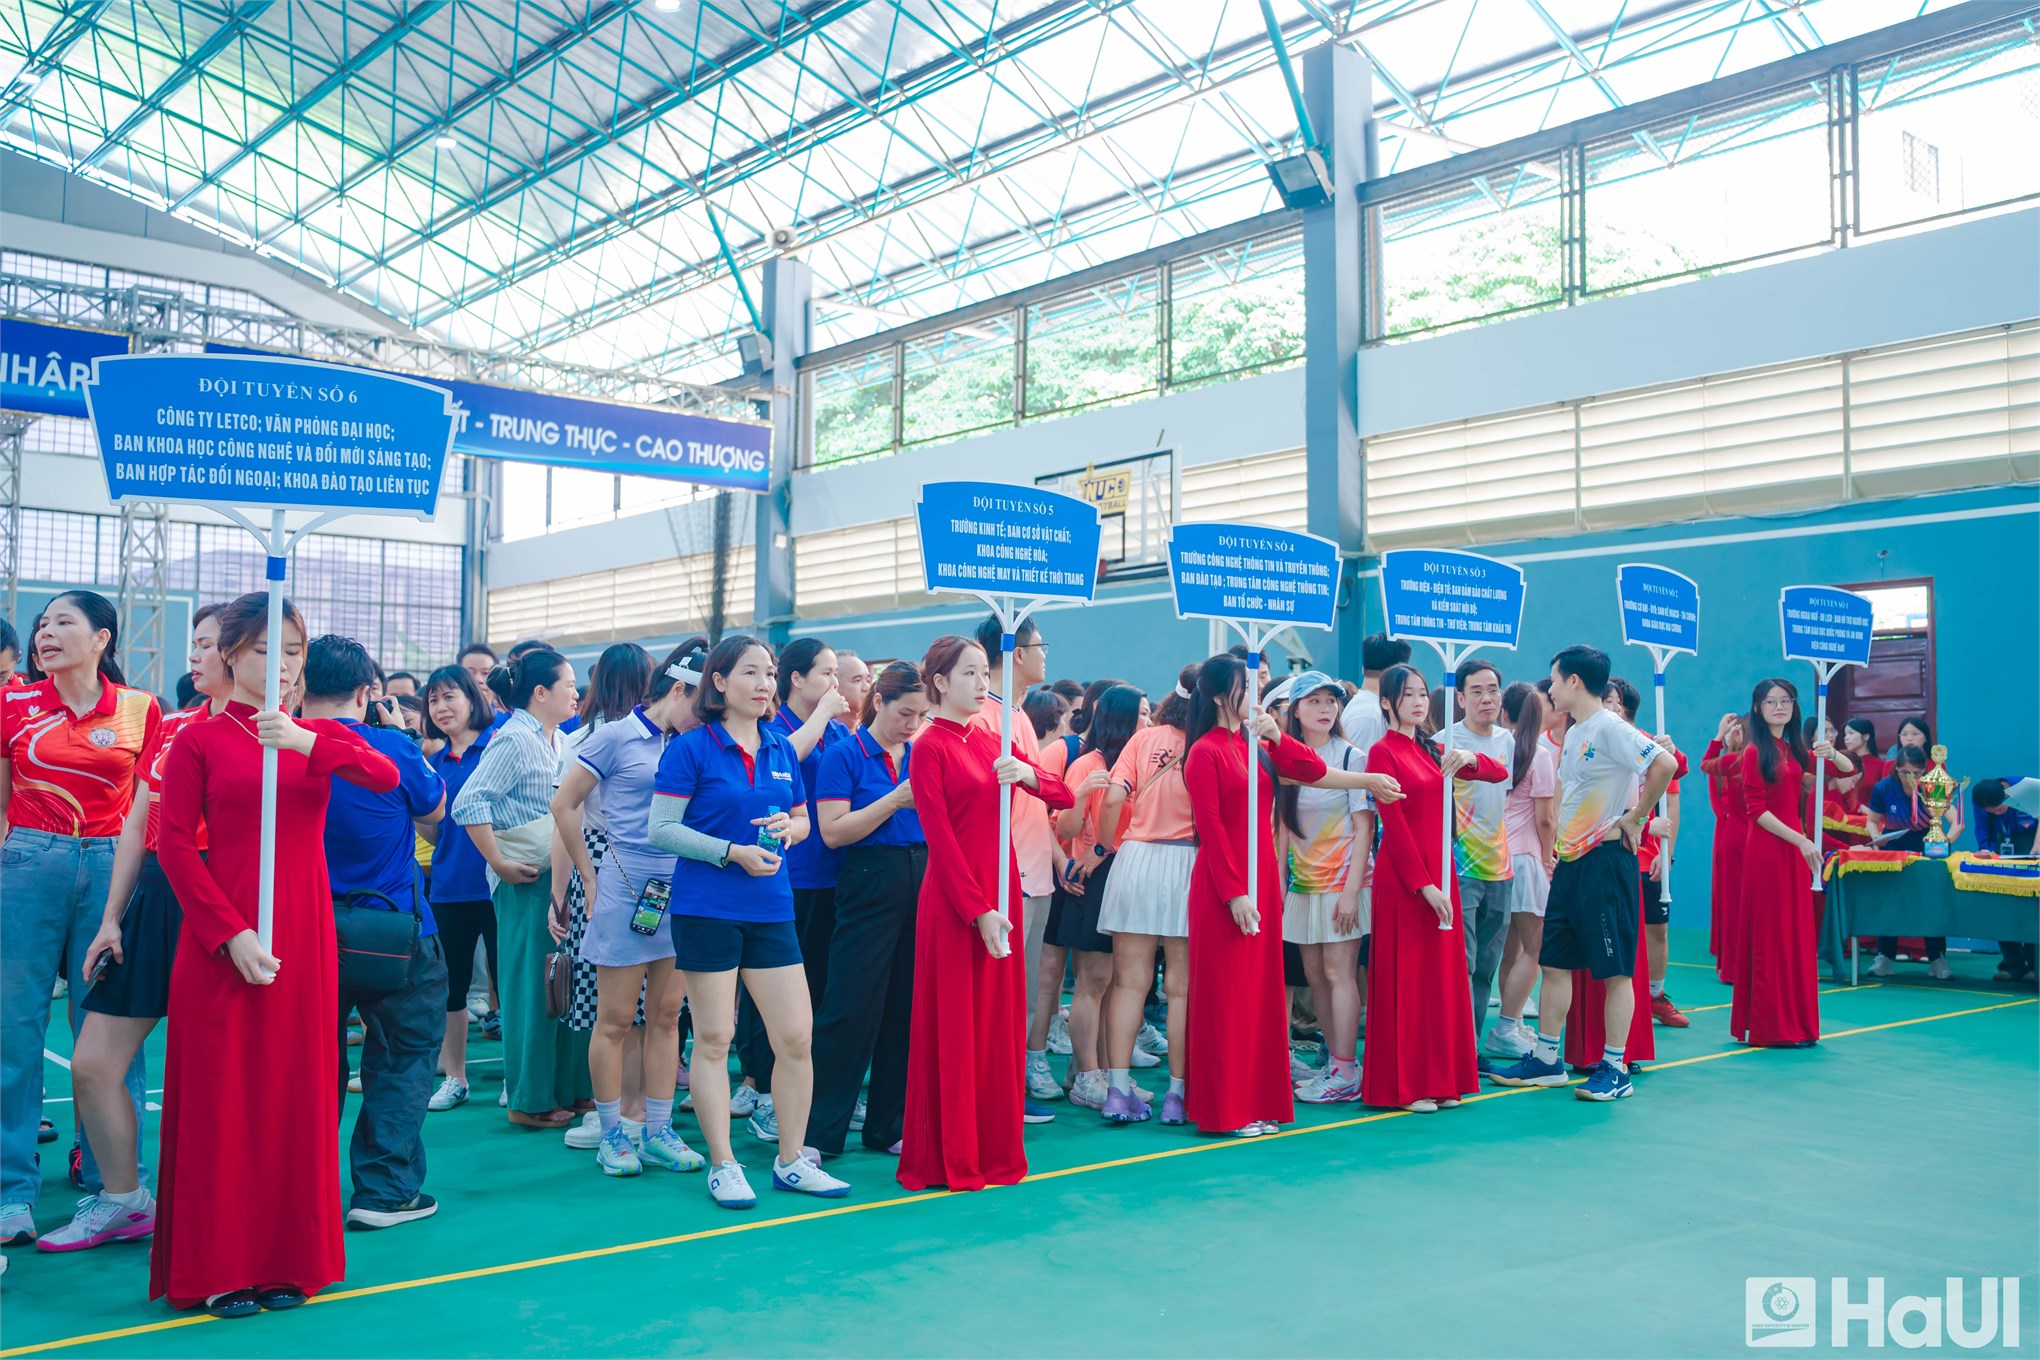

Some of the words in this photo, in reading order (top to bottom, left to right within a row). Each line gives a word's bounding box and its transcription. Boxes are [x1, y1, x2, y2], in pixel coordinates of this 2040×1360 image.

[198, 377, 237, 397] ĐỘI
[243, 380, 312, 400] TUYỂN
[318, 384, 344, 402] SỐ
[349, 390, 358, 404] 6
[157, 406, 194, 426] CÔNG
[198, 411, 213, 428] TY
[217, 413, 262, 433] LETCO;
[265, 413, 291, 433] VĂN
[295, 416, 338, 436] PHÒNG
[342, 421, 362, 440] ĐẠI
[366, 423, 395, 442] HỌC;
[114, 434, 143, 452] BAN
[147, 436, 184, 454] KHOA
[188, 439, 214, 459] HỌC
[218, 438, 254, 458] CÔNG
[258, 442, 292, 464] NGHỆ
[296, 443, 312, 462] VÀ
[316, 441, 336, 463] ĐỔI
[340, 446, 364, 464] MỚI
[368, 447, 401, 467] SÁNG
[405, 452, 431, 471] TẠO;
[490, 413, 560, 445] TRUNG
[564, 424, 617, 456] THỰC
[636, 435, 683, 462] CAO
[687, 441, 765, 473] THƯỢNG
[116, 463, 144, 480] BAN
[149, 464, 176, 485] HỢP
[180, 464, 205, 483] TÁC
[209, 463, 231, 485] ĐỐI
[236, 469, 280, 490] NGOẠI;
[284, 472, 318, 490] KHOA
[322, 471, 346, 490] ĐÀO
[350, 475, 373, 495] TẠO
[377, 475, 404, 494] LIÊN
[407, 479, 429, 498] TỤC
[973, 496, 992, 511] ĐỘI
[1049, 504, 1053, 515] 5
[951, 518, 977, 534] TRƯỜNG
[979, 522, 994, 536] KINH
[996, 521, 1006, 538] TẾ;
[1008, 524, 1020, 539] BAN
[1022, 525, 1031, 540] CƠ
[1032, 524, 1040, 541] SỞ
[1041, 527, 1052, 544] VẬT
[1054, 527, 1071, 544] CHẤT;
[977, 544, 994, 558] KHOA
[996, 544, 1013, 559] CÔNG
[1015, 546, 1032, 564] NGHỆ
[1033, 546, 1048, 564] HÓA;
[938, 563, 956, 577] KHOA
[958, 562, 976, 579] CÔNG
[978, 564, 995, 583] NGHỆ
[997, 567, 1010, 580] MAY
[1012, 567, 1020, 582] VÀ
[1022, 565, 1038, 583] THIẾT
[1040, 566, 1048, 583] KẾ
[1049, 570, 1063, 585] THỜI
[1064, 572, 1084, 586] TRANG
